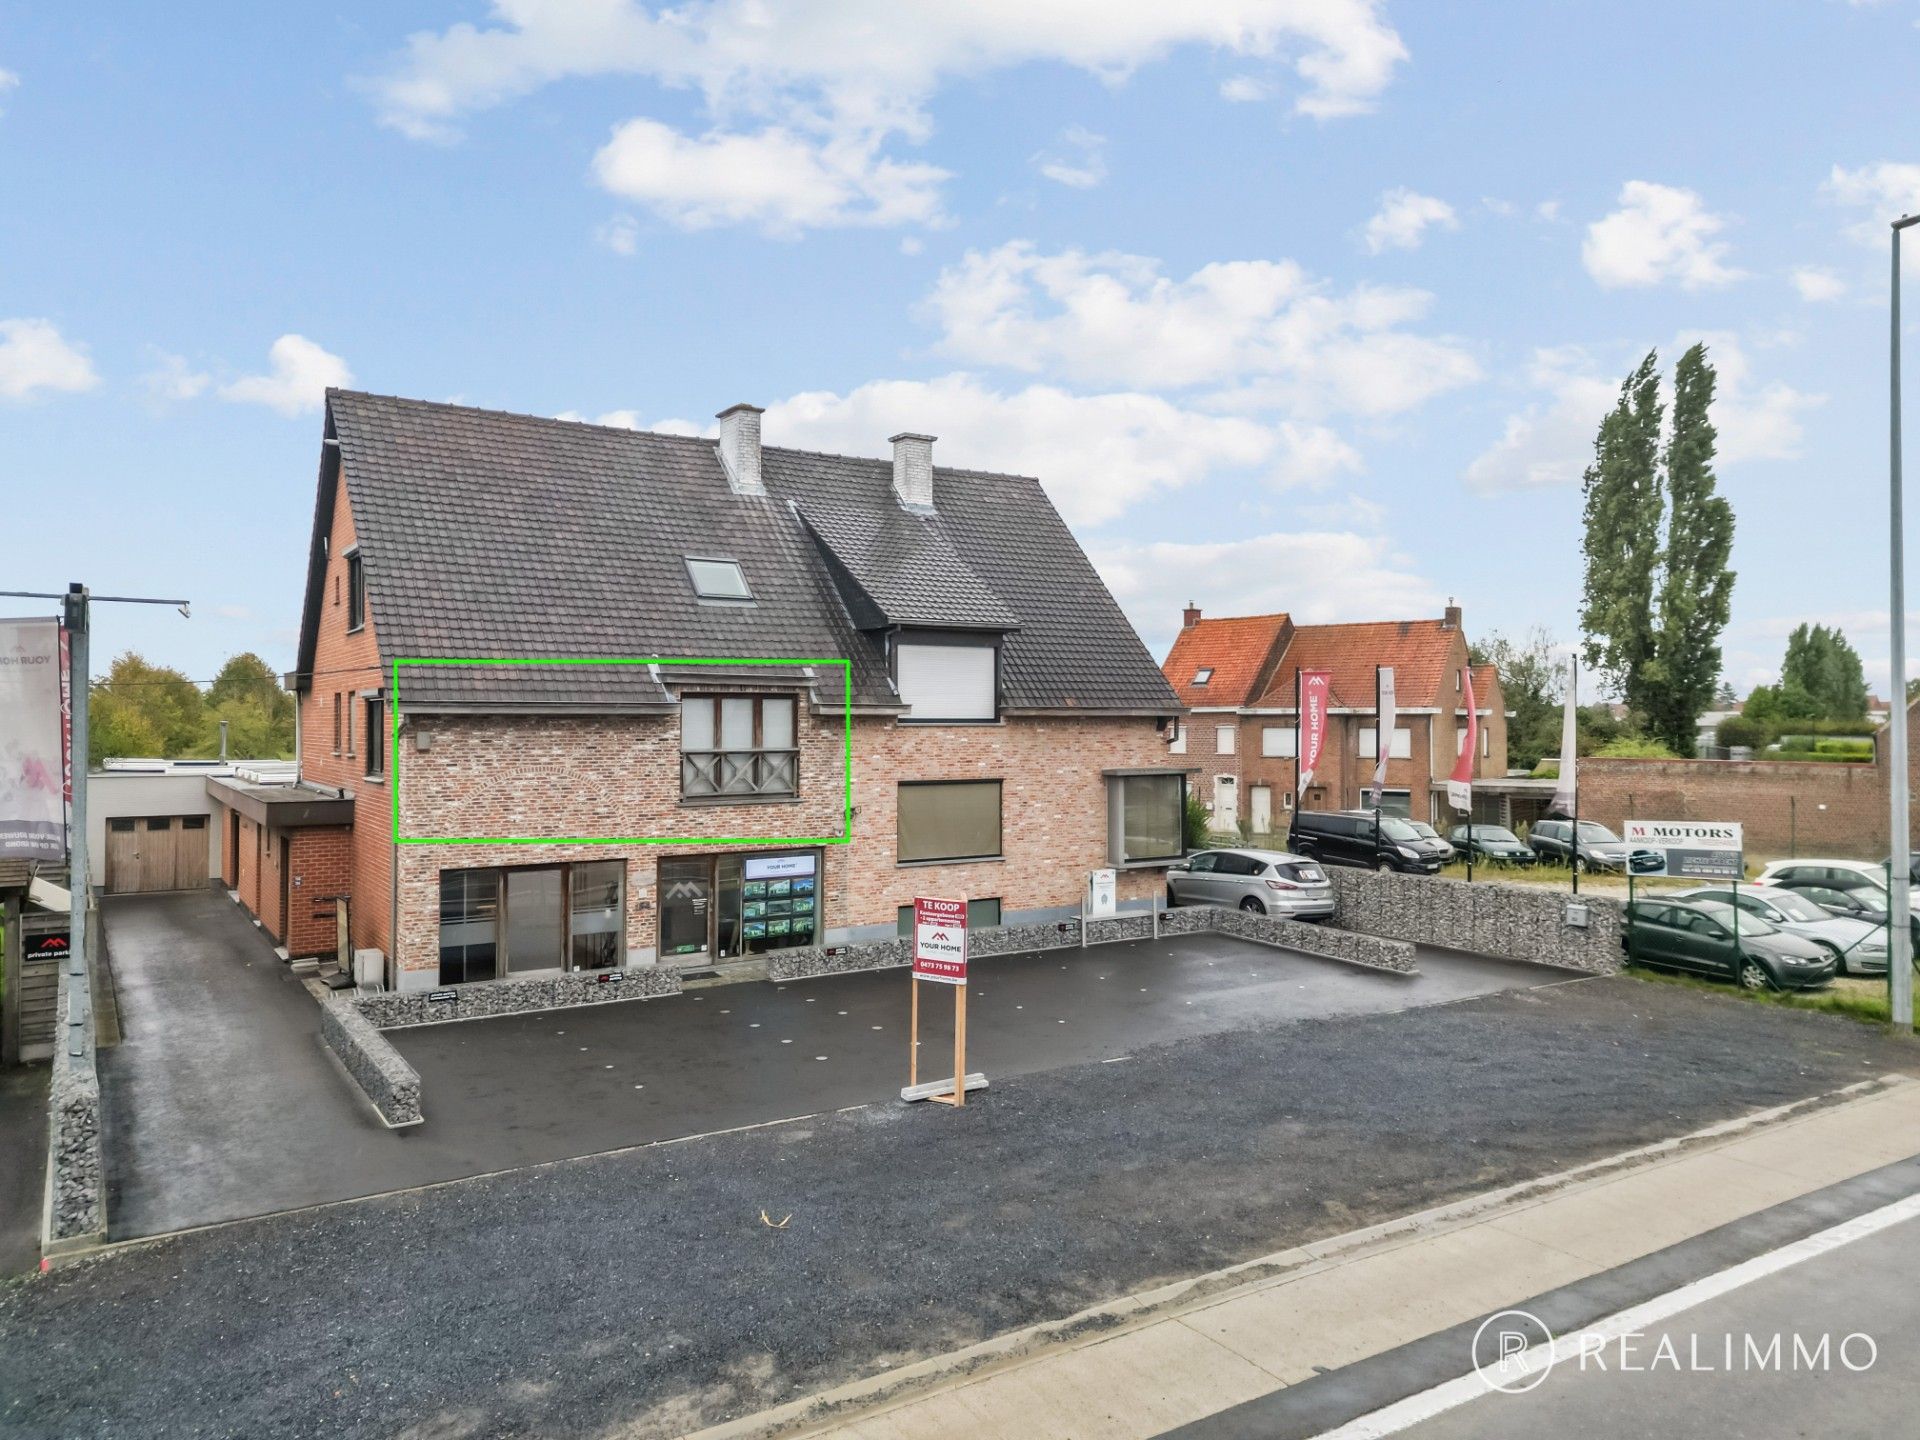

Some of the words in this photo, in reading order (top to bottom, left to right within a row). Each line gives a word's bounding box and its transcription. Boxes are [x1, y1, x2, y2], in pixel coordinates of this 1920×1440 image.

[1309, 695, 1319, 730] HOME
[1308, 732, 1319, 766] YOUR
[1632, 826, 1646, 837] M
[1653, 827, 1734, 838] MOTORS
[923, 900, 934, 910] TE
[934, 902, 960, 911] KOOP
[920, 942, 939, 950] YOUR
[940, 944, 962, 952] HOME
